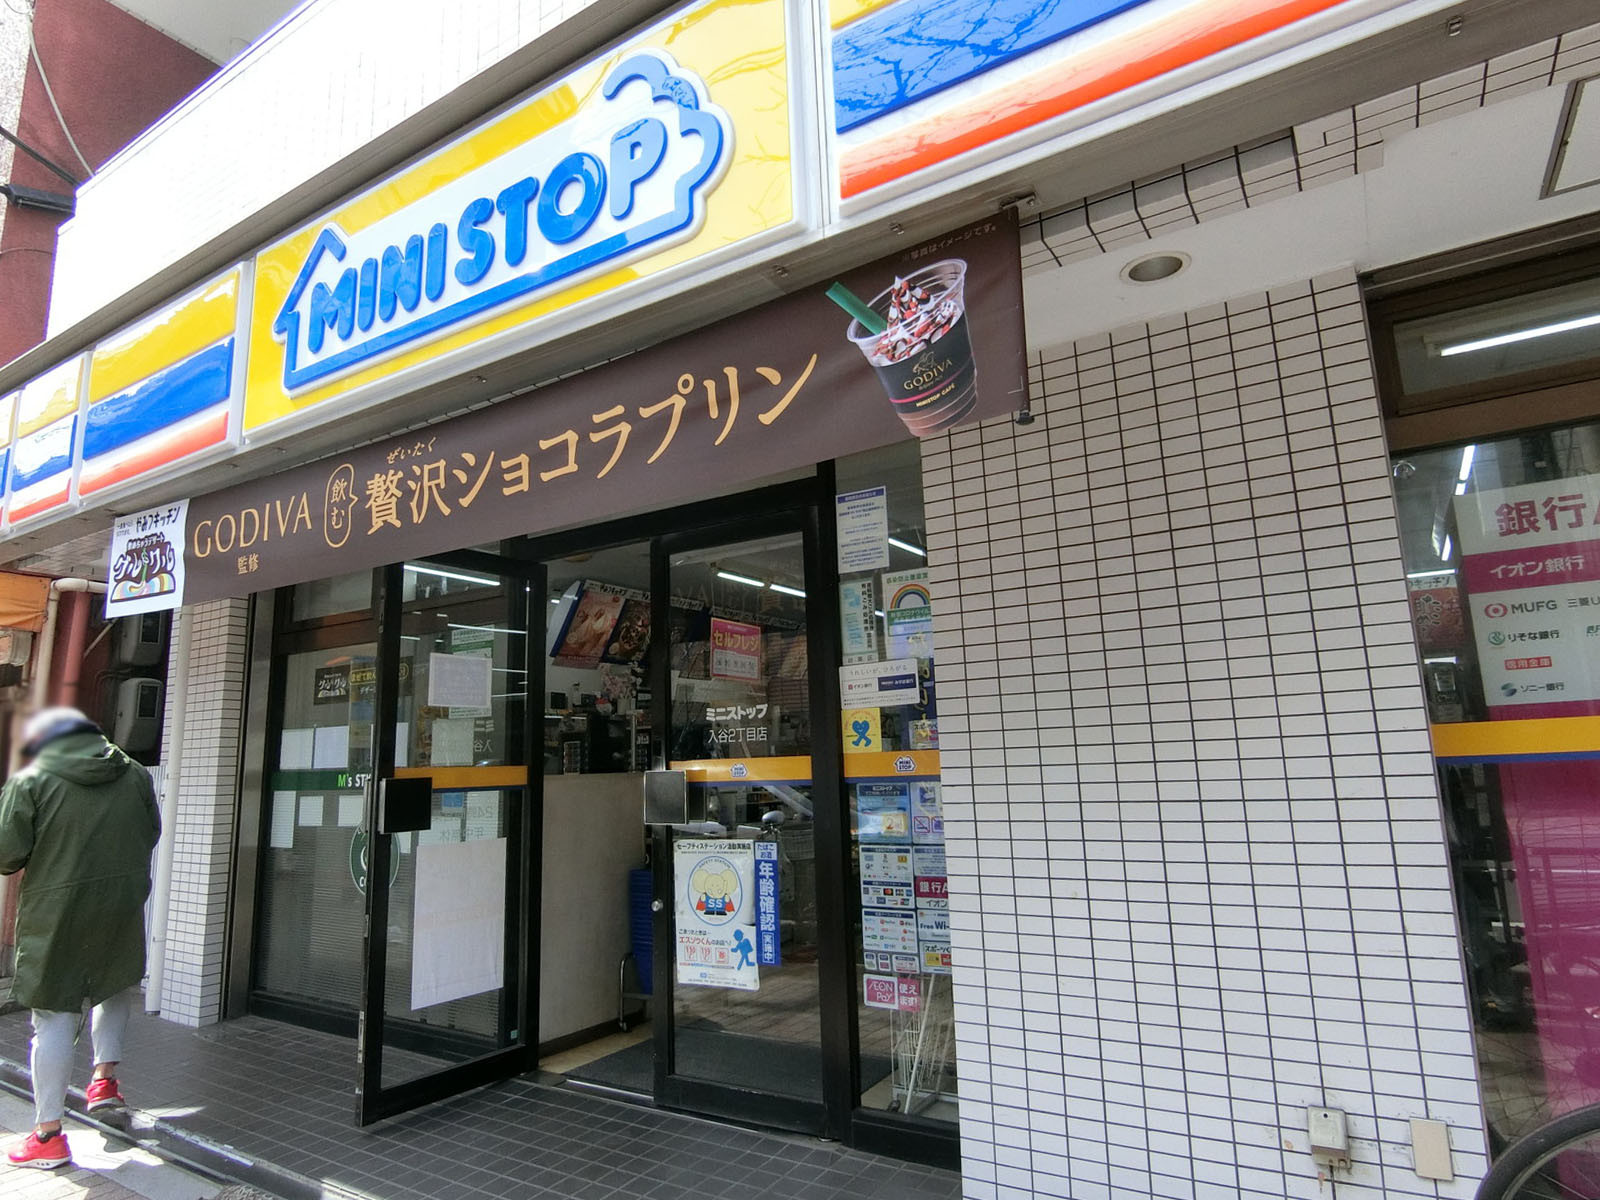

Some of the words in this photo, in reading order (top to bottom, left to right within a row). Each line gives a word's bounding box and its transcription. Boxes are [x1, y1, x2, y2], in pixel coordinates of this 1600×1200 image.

[308, 117, 668, 354] MINISTOP
[903, 359, 953, 391] GODIVA
[364, 353, 818, 535] 贅沢ショコラプリン
[386, 436, 437, 465] ぜいたく
[331, 478, 348, 530] 飲む
[193, 491, 313, 558] GODIVA
[237, 552, 260, 576] 監修
[1490, 555, 1585, 579] イオン銀行
[1511, 599, 1558, 614] MUFG
[713, 629, 759, 652] セルフレジ
[1507, 629, 1560, 642] りそな銀行
[1520, 682, 1565, 693] ソニー銀行
[705, 703, 769, 722] ミニストップ
[707, 727, 769, 744] 入谷2丁目店
[338, 774, 352, 788] M's
[707, 899, 723, 908] SS
[758, 861, 775, 932] 年齢確認
[927, 899, 948, 908] イオン
